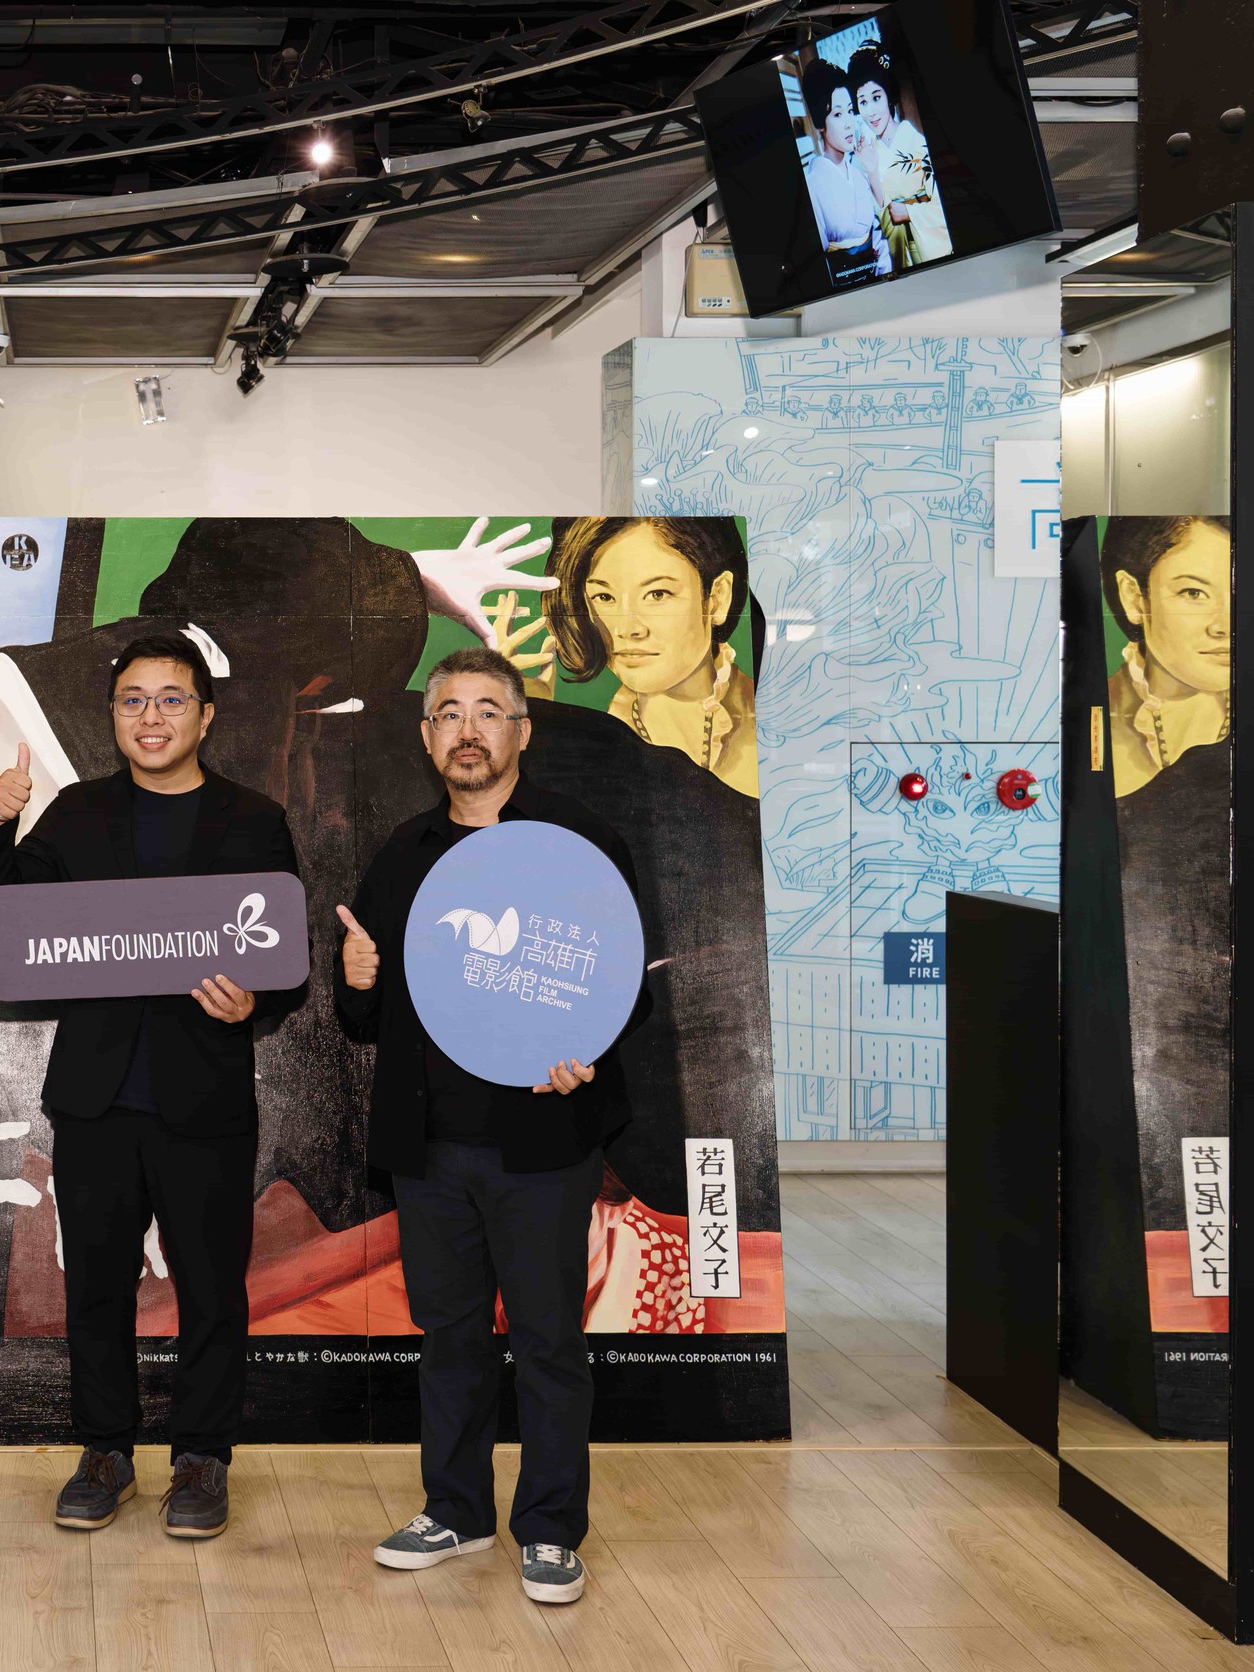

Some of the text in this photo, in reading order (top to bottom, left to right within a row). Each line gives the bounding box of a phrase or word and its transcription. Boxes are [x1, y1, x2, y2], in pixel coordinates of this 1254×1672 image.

[528, 913, 600, 946] 行政法人
[521, 931, 598, 982] 高雄市
[909, 937, 934, 964] 消
[463, 952, 538, 1002] 電影館
[909, 967, 940, 978] FIRE
[538, 985, 558, 997] FILM
[540, 975, 589, 996] KAOHSIUNG
[536, 995, 573, 1011] ARCHIVE
[696, 1147, 730, 1291] 若尾文子
[678, 1352, 751, 1363] CORPORATION
[755, 1353, 777, 1363] 1961
